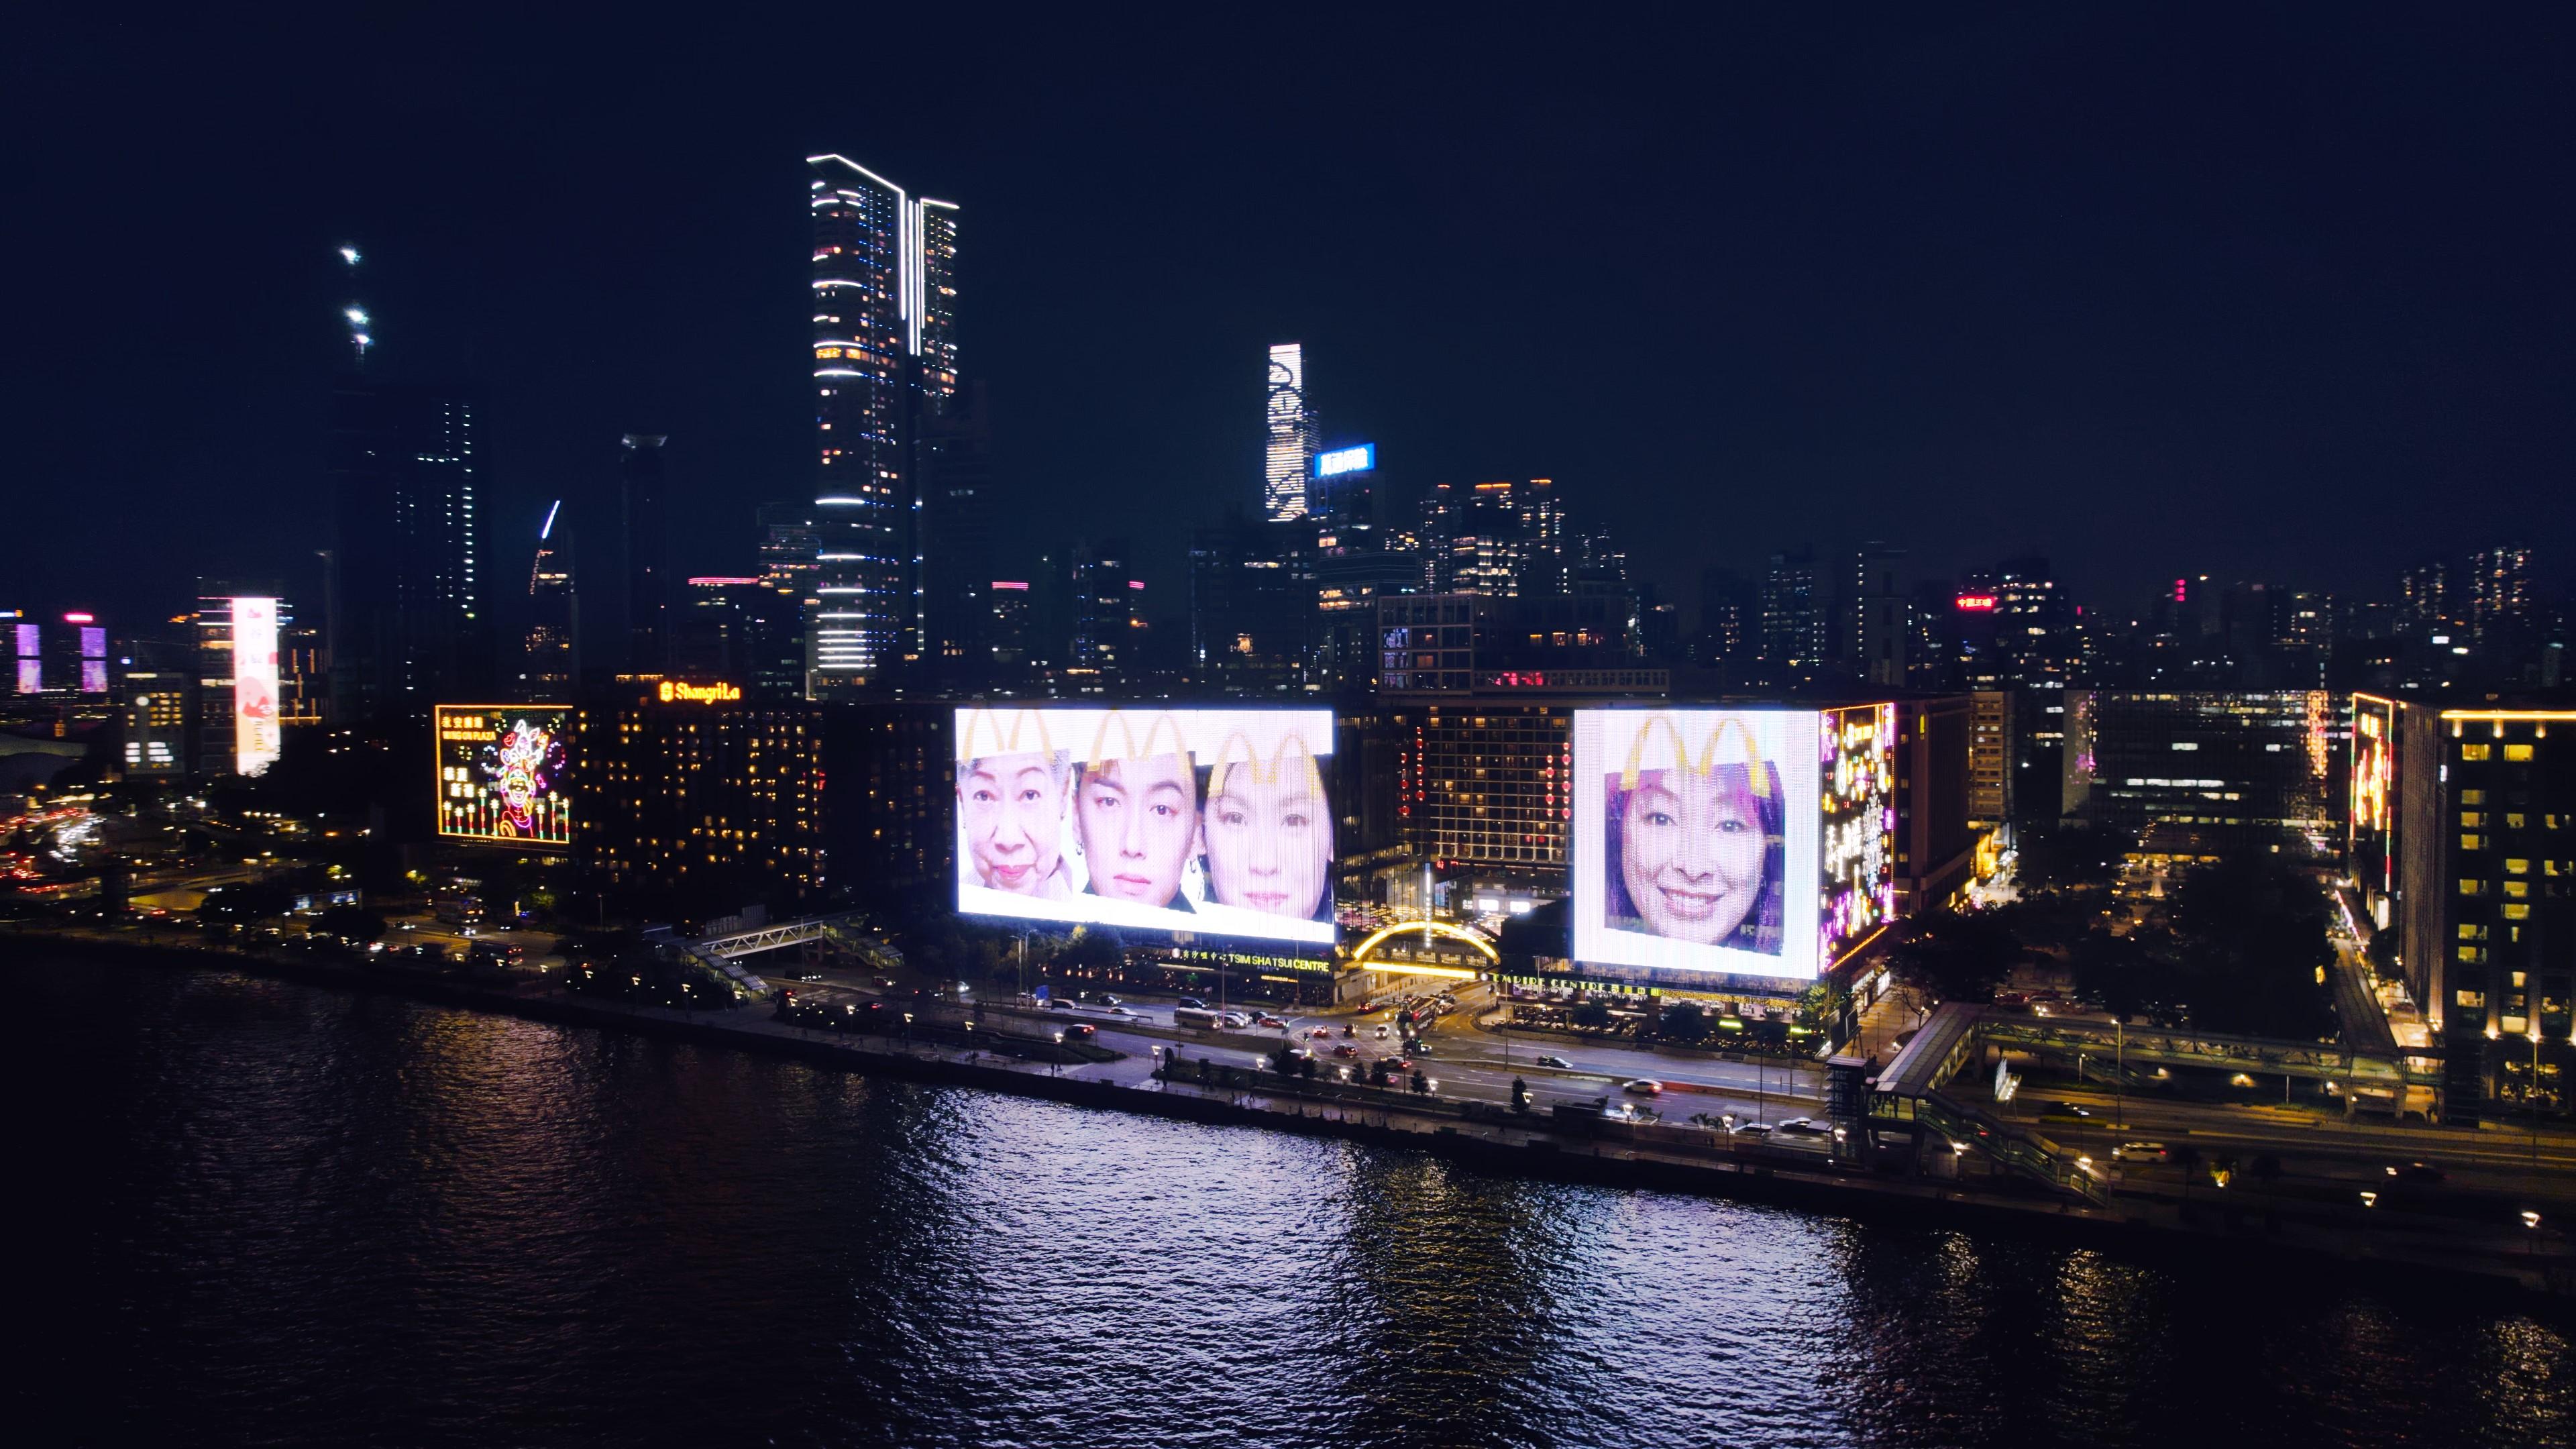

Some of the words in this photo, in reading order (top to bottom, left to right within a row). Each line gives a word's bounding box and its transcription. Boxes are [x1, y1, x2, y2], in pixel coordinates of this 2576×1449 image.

[473, 731, 496, 741] PLAZA
[1228, 953, 1250, 965] TSIM
[1252, 957, 1271, 967] SHA
[1272, 958, 1293, 968] TSUI
[1293, 961, 1330, 972] CENTRE
[1493, 974, 1545, 986] EMPIRE
[1551, 979, 1605, 991] CENTRE
